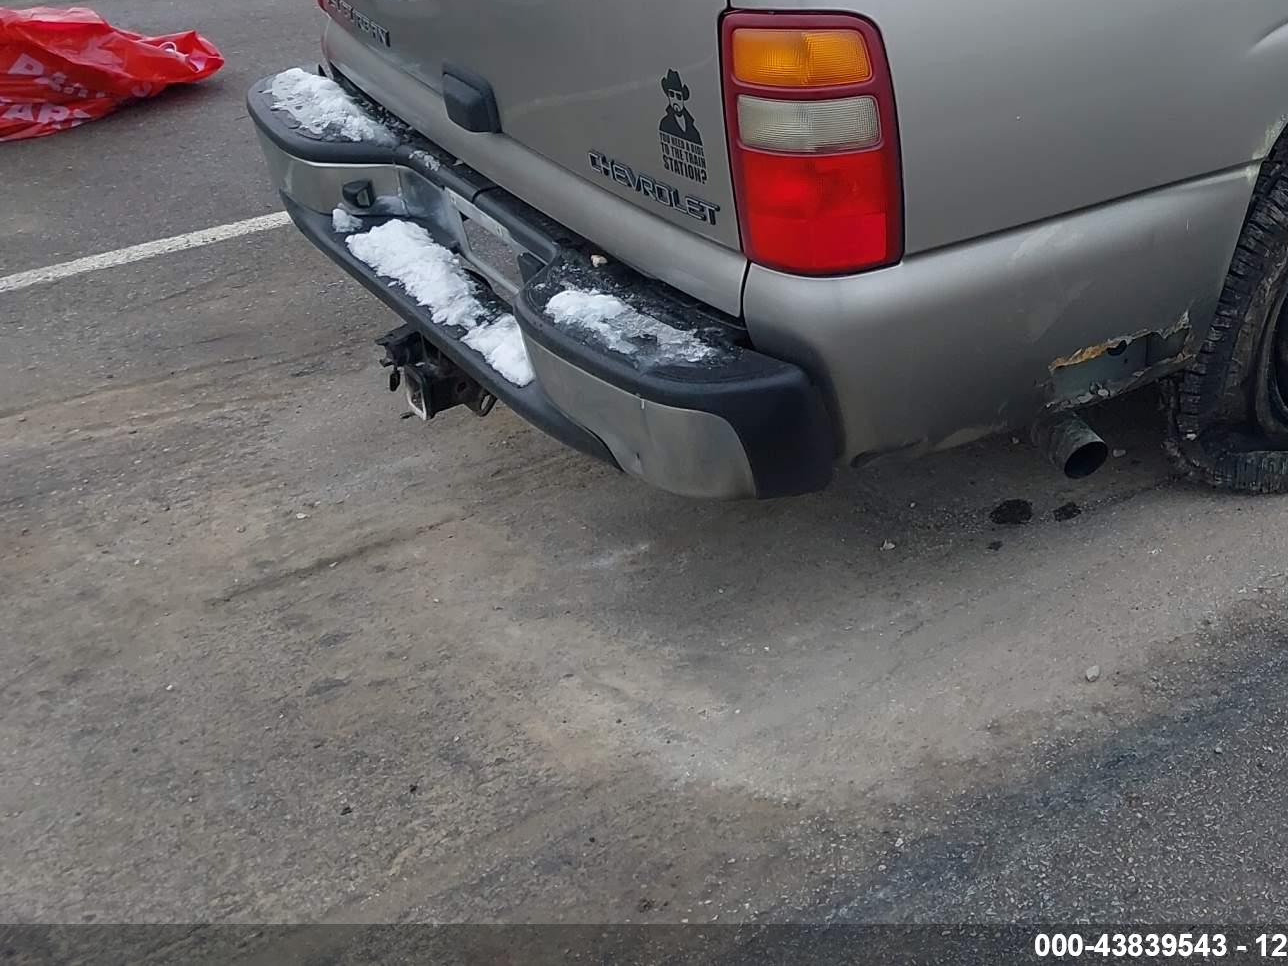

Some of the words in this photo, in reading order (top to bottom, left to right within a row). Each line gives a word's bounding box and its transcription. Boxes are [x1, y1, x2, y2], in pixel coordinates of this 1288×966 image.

[661, 142, 669, 155] TO
[669, 145, 684, 161] THE
[684, 151, 707, 171] TRAIN
[671, 136, 685, 150] NEED
[662, 154, 708, 185] STATION?
[587, 149, 721, 226] CHEVROLET
